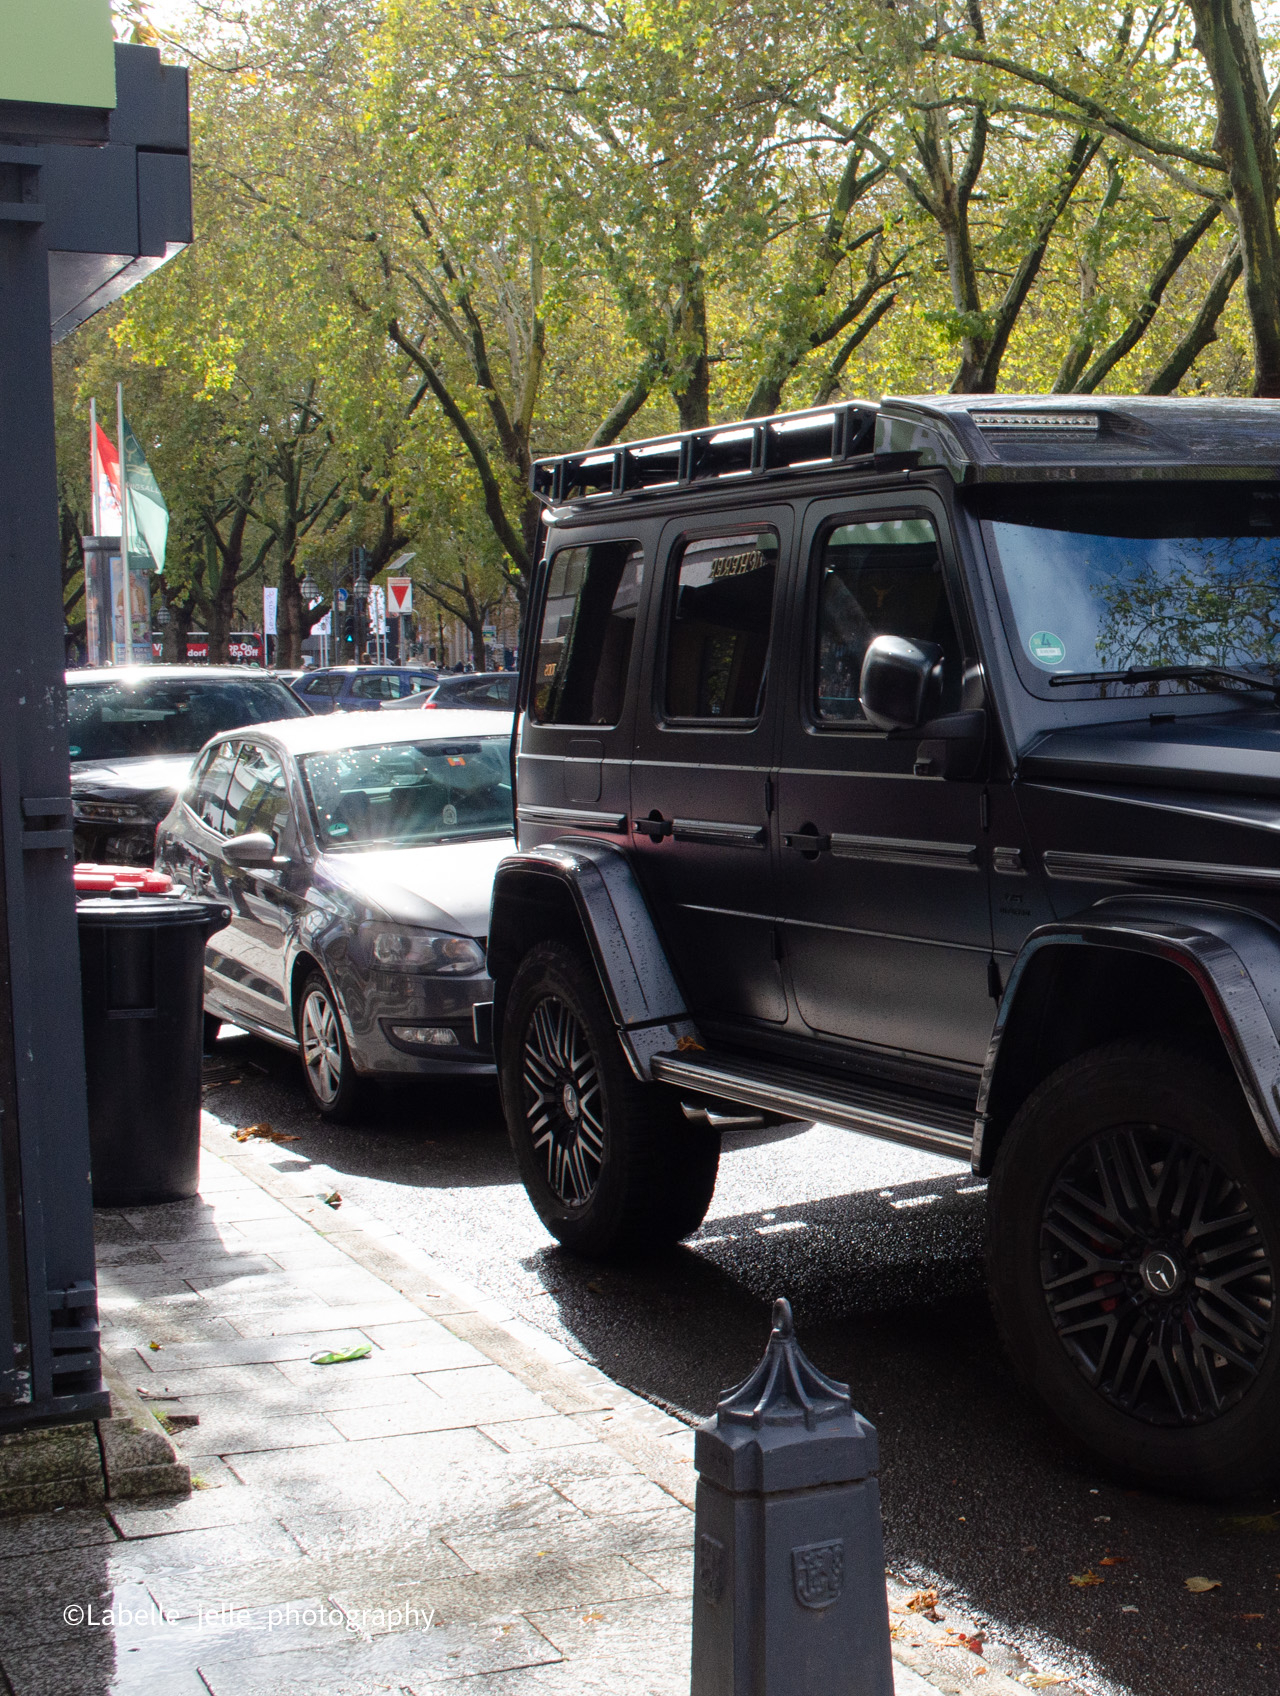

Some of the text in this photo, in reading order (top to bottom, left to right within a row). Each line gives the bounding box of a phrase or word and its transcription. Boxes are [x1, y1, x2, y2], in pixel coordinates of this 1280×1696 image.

[1041, 634, 1051, 648] 4
[240, 643, 253, 651] On
[187, 649, 207, 657] dorf
